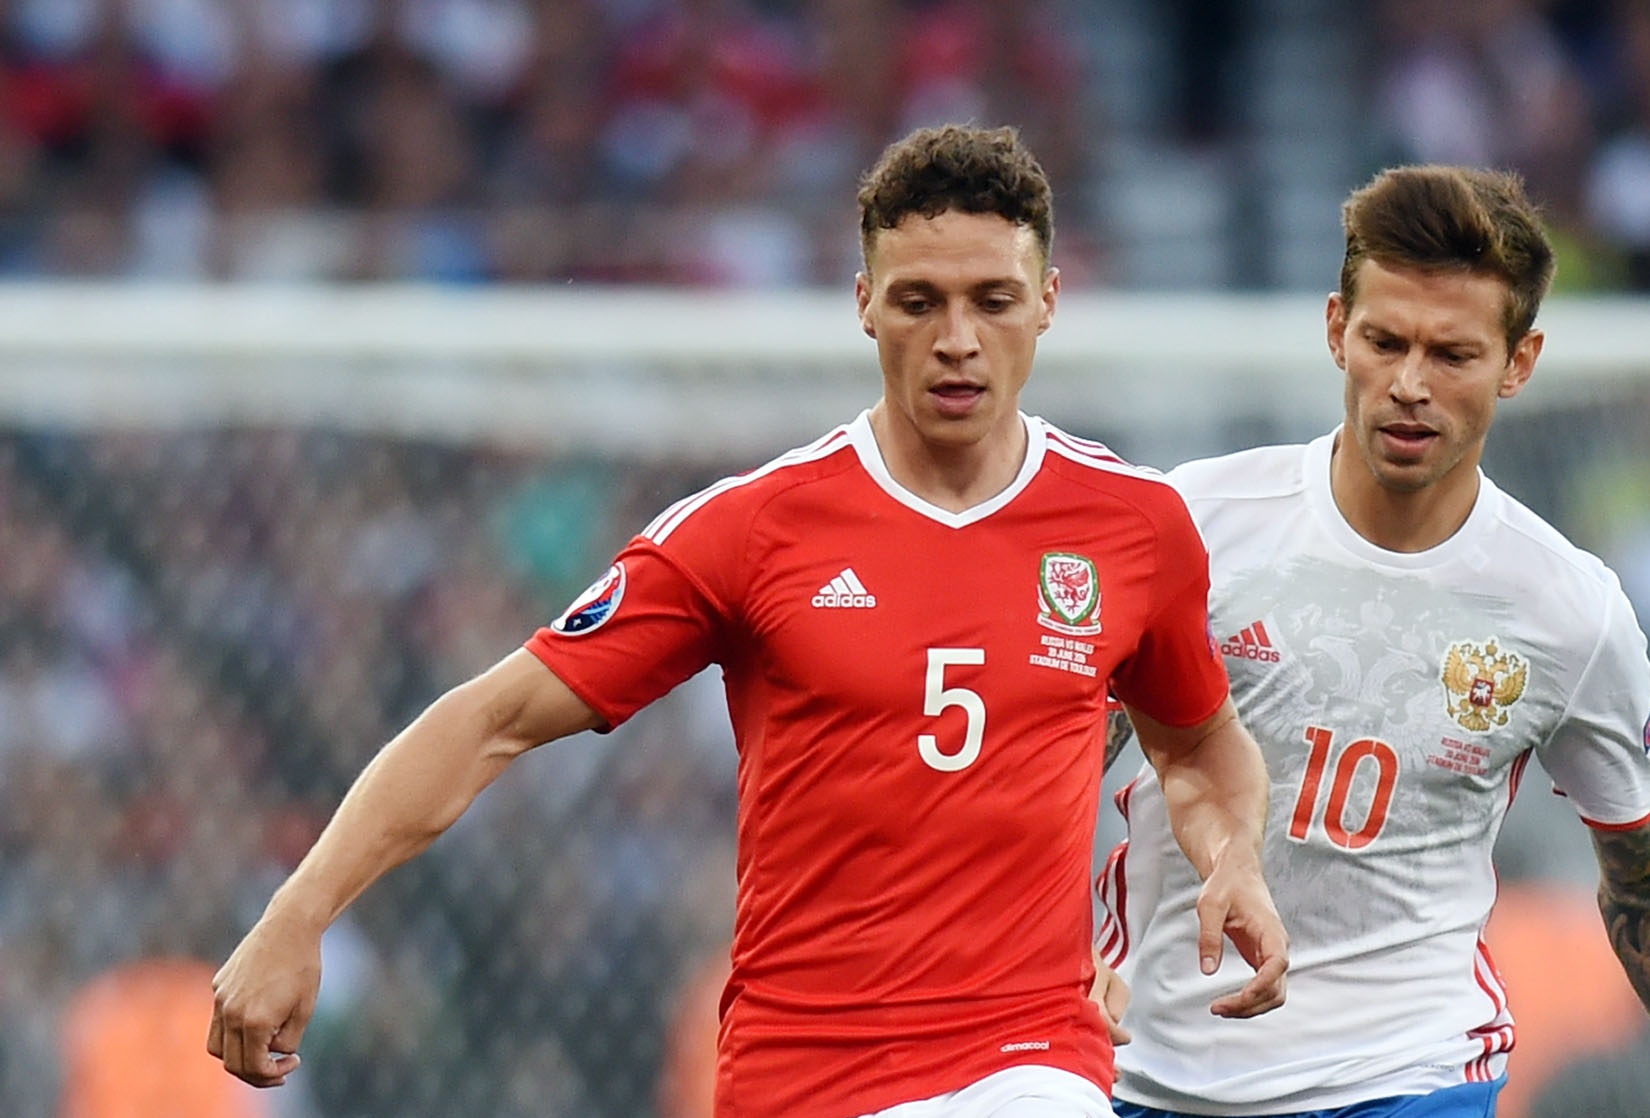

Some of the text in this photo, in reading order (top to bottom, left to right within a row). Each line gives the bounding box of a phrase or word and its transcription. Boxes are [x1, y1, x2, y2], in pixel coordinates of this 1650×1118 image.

[811, 592, 877, 608] adidas
[1221, 643, 1281, 663] adidas
[918, 647, 986, 772] 5
[1286, 724, 1400, 853] 10
